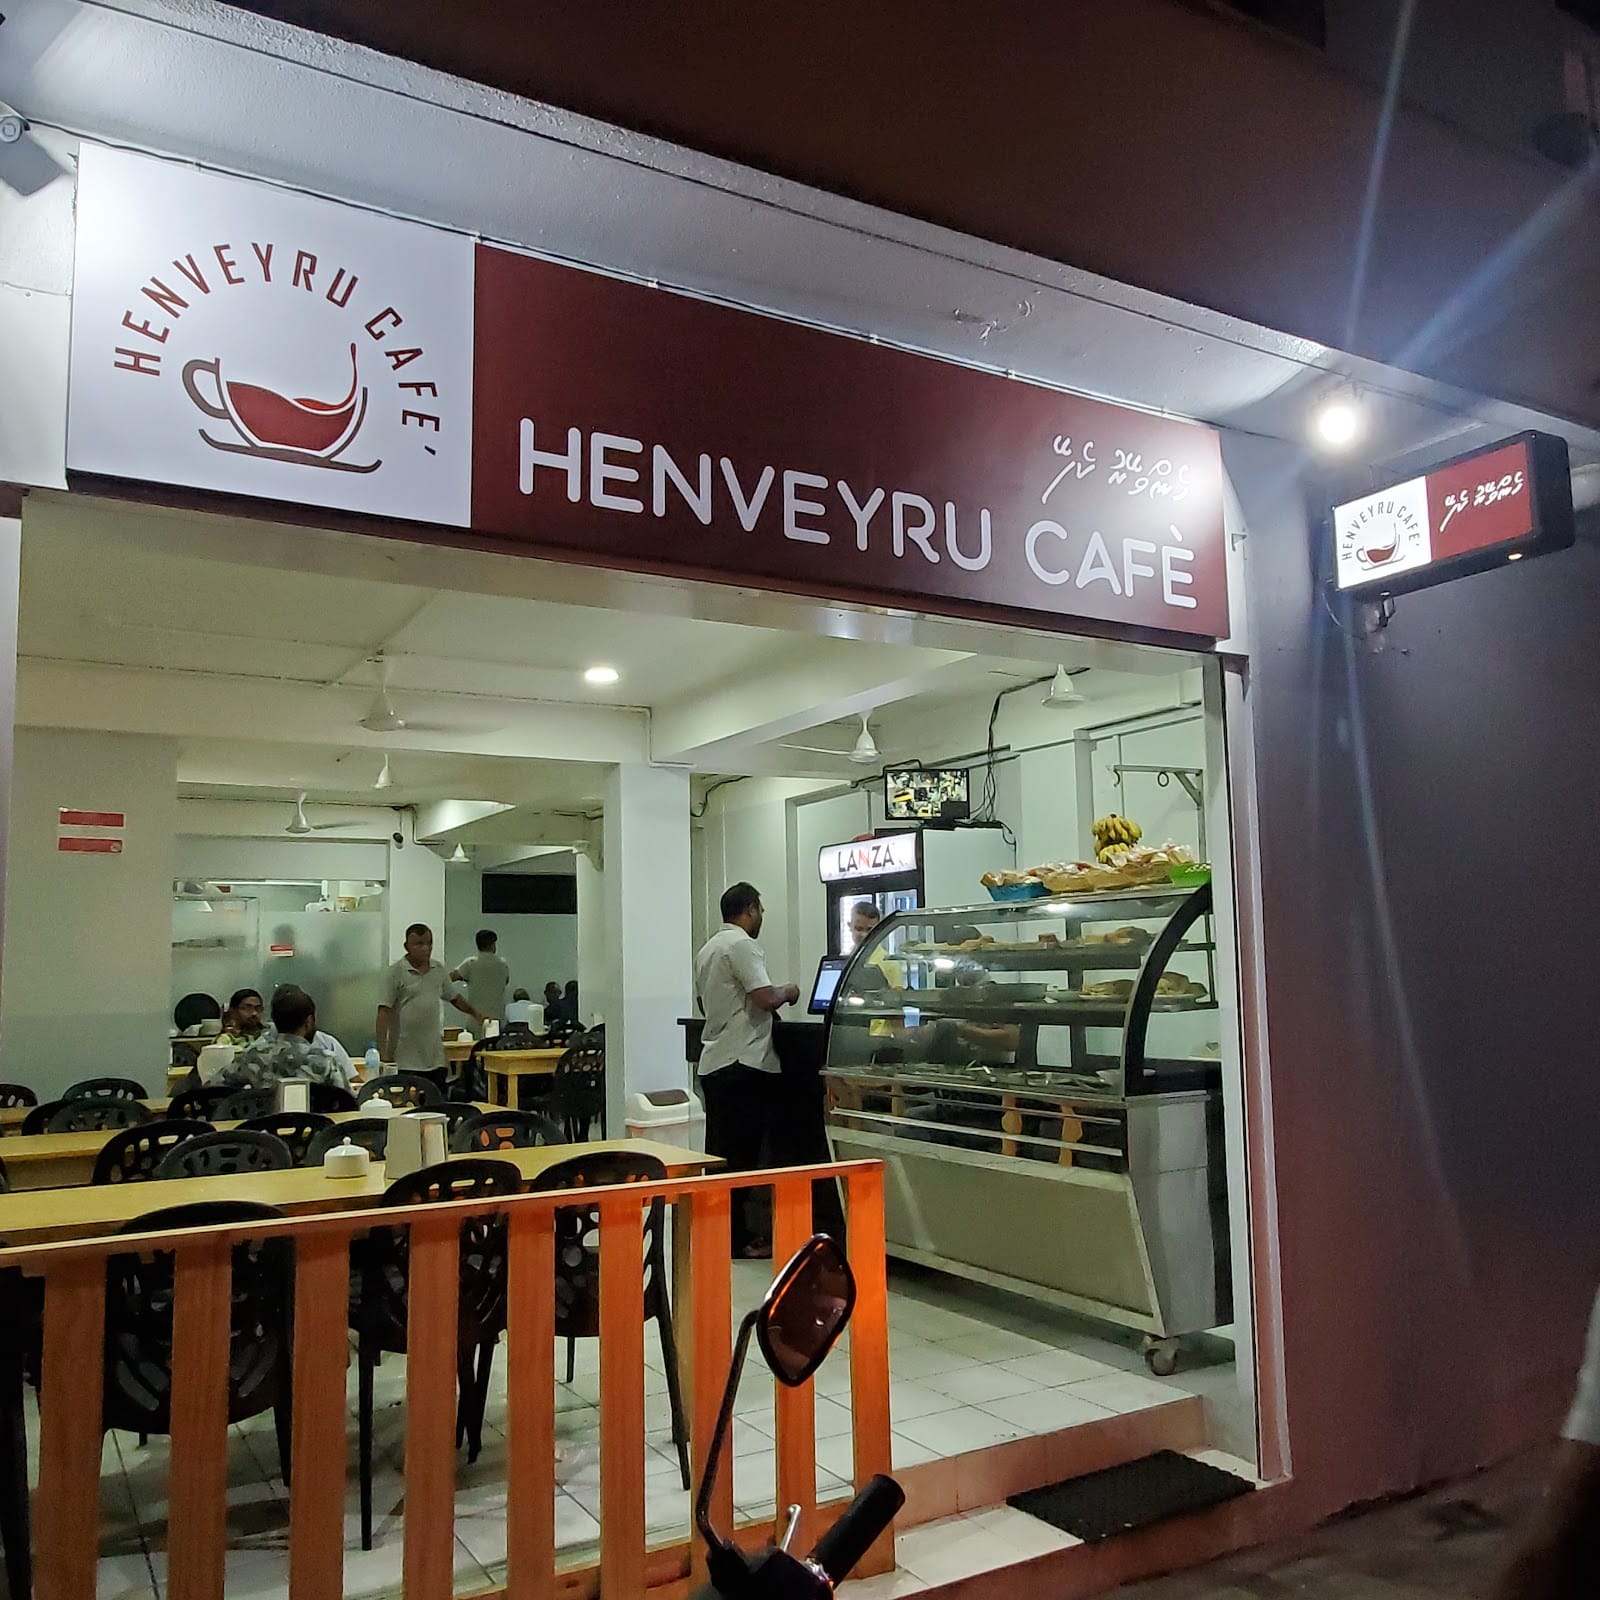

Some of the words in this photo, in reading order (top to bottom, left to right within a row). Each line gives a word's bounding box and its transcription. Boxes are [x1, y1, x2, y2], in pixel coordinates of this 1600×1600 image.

[114, 243, 358, 376] HENVEYRU
[519, 417, 992, 571] HENVEYRU
[1024, 520, 1197, 609] CAFÈ
[1341, 501, 1395, 561] HENVEYRU
[838, 843, 895, 872] LANZA
